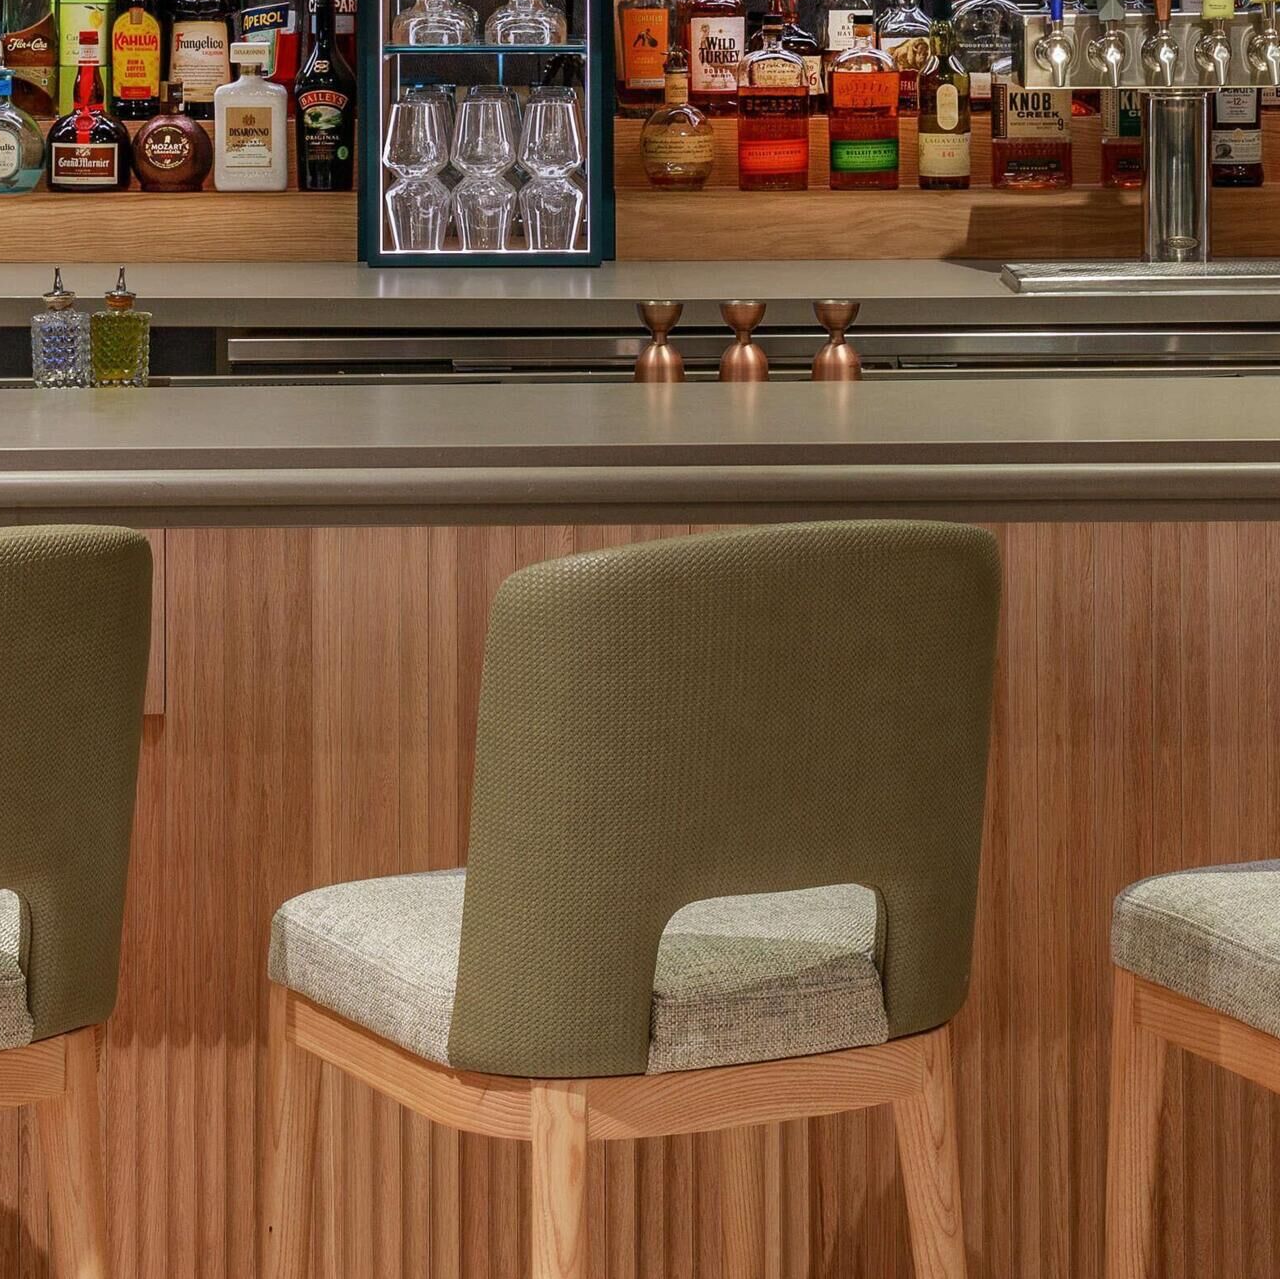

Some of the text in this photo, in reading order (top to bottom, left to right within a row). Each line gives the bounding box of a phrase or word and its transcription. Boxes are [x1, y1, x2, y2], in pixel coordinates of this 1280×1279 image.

[243, 10, 284, 31] APEROL
[7, 37, 26, 51] Flor
[114, 31, 159, 52] KAHLÚA
[175, 32, 224, 52] Frangelico
[705, 36, 736, 51] WILD
[698, 47, 740, 65] TURKEY
[302, 93, 345, 107] BAILEYS
[1009, 92, 1052, 111] KNOB
[1233, 98, 1242, 106] 12
[1057, 118, 1064, 131] 9
[229, 127, 269, 137] DISARONNO
[150, 143, 183, 151] MOZART
[58, 157, 110, 168] Grand Marnier
